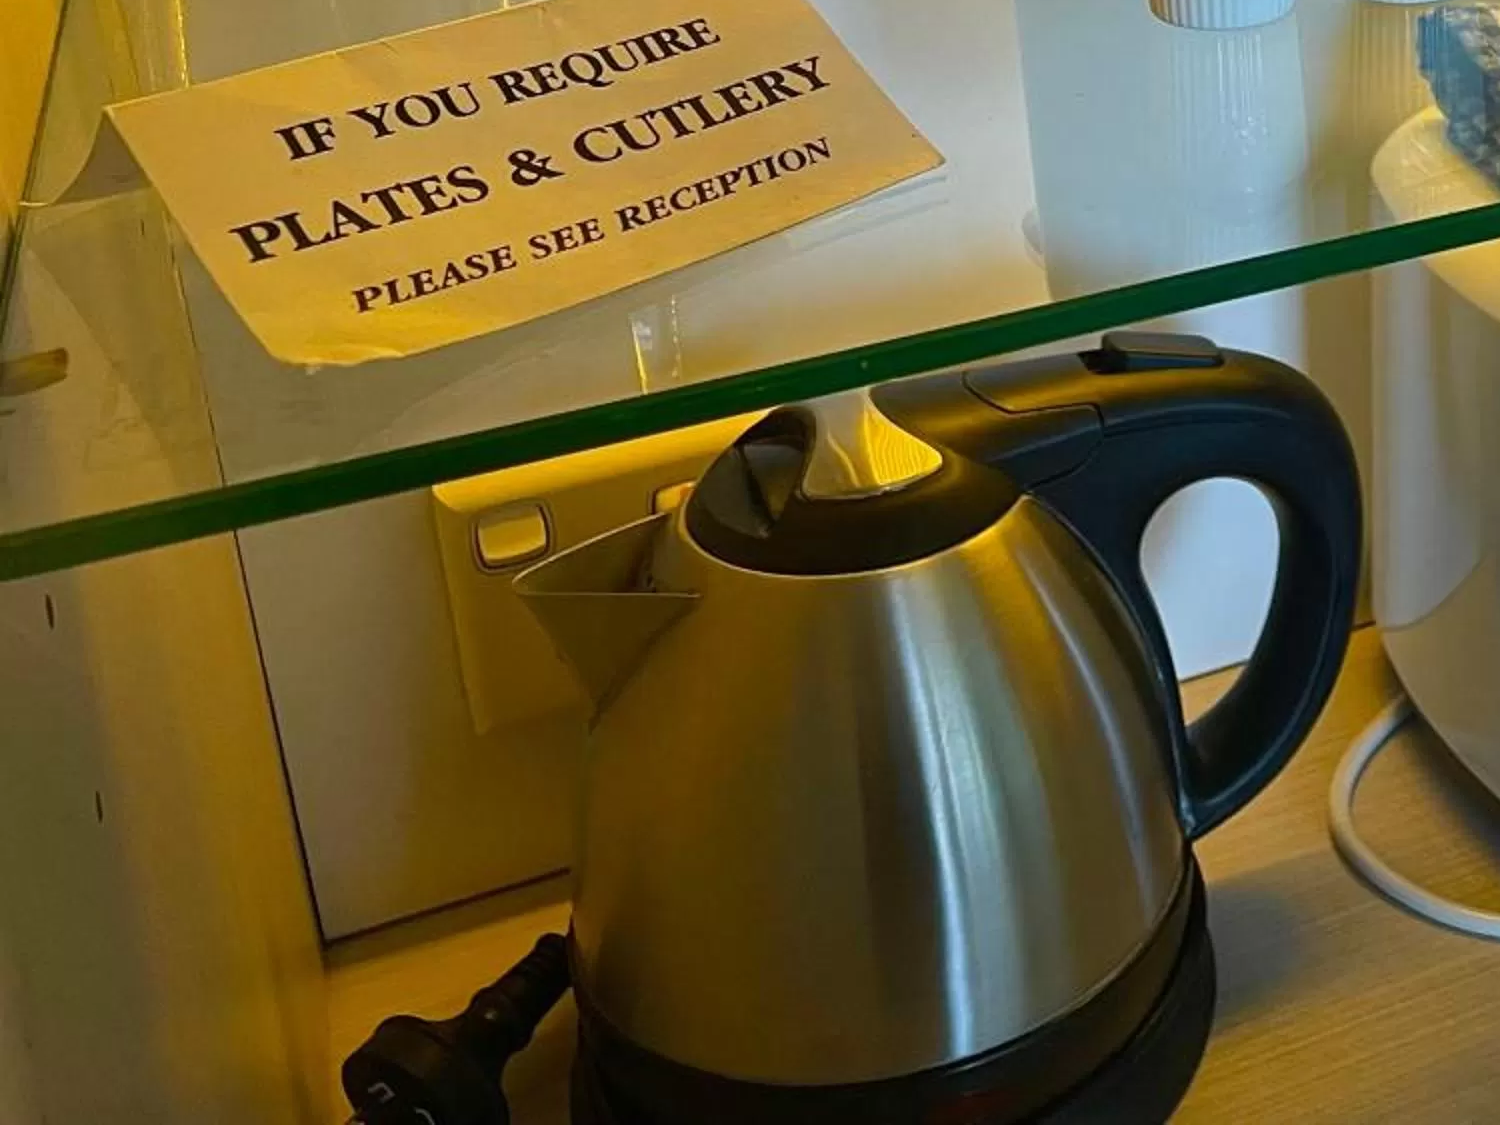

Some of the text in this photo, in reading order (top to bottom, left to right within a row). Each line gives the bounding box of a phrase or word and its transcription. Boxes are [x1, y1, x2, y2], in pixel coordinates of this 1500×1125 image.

[228, 56, 831, 263] PLATES & CUTLERY
[273, 18, 721, 161] IF YOU REQUIRE
[351, 137, 832, 313] PLEASE SEE RECEPTION
